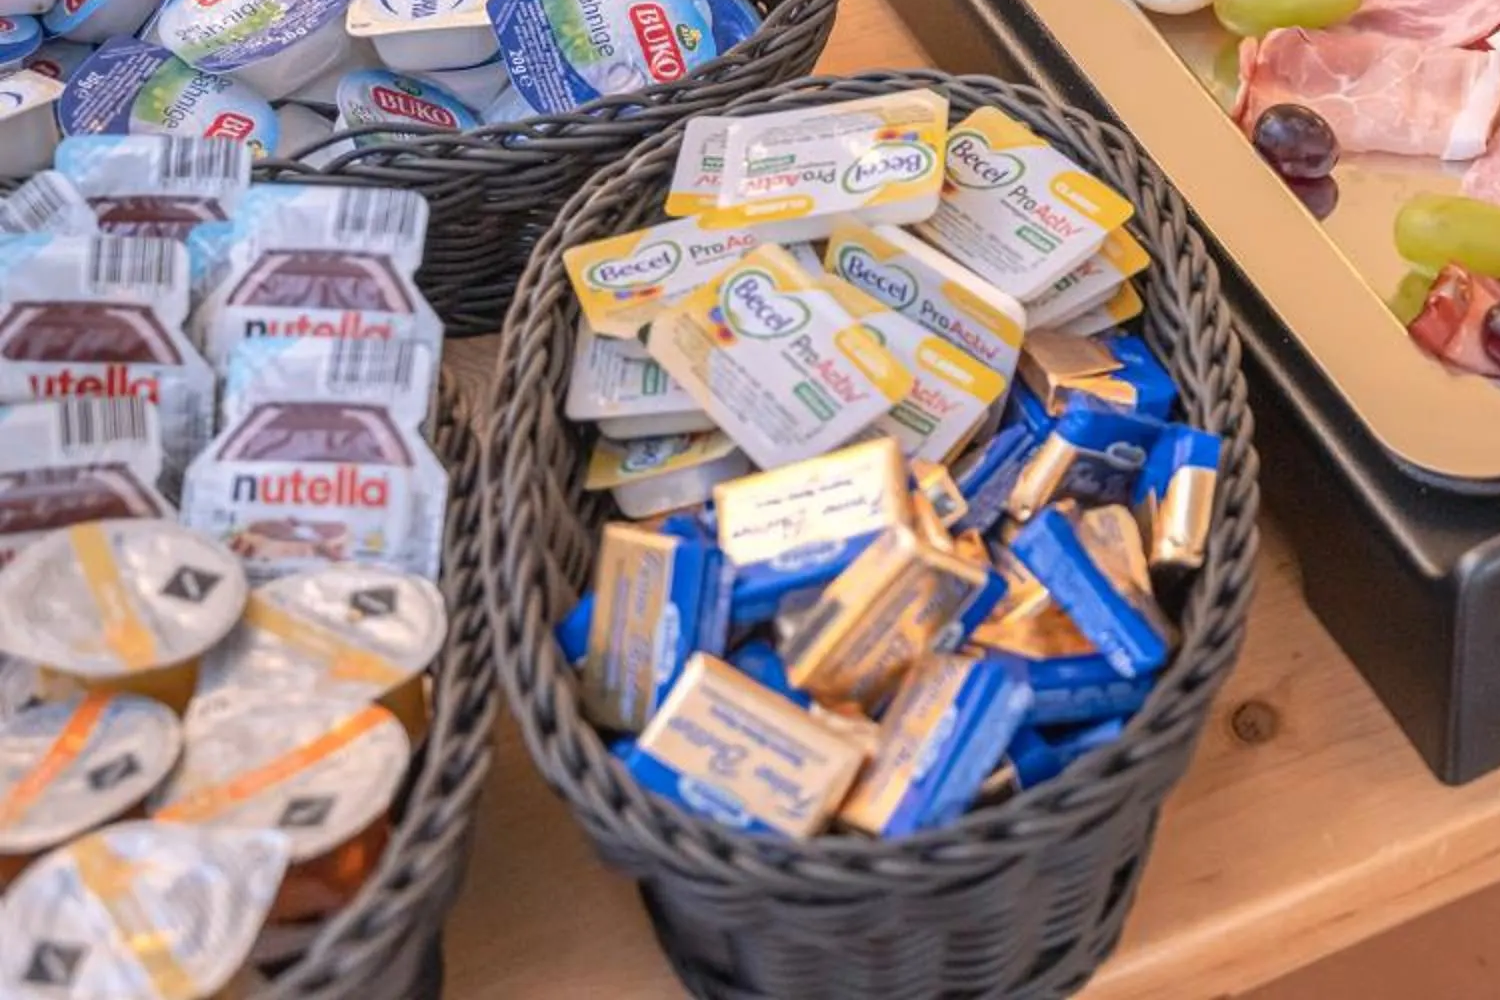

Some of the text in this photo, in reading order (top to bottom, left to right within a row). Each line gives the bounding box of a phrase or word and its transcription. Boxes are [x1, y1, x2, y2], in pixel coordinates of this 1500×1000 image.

[635, 5, 682, 80] BUKO
[378, 90, 452, 127] BUKO
[853, 151, 923, 184] Becel
[951, 138, 1009, 184] Becel
[1007, 184, 1086, 239] ProActiv
[599, 250, 673, 282] Becel
[688, 233, 757, 260] ProAc
[849, 254, 909, 304] Becel
[733, 277, 795, 332] Becel
[232, 462, 389, 511] nutella
